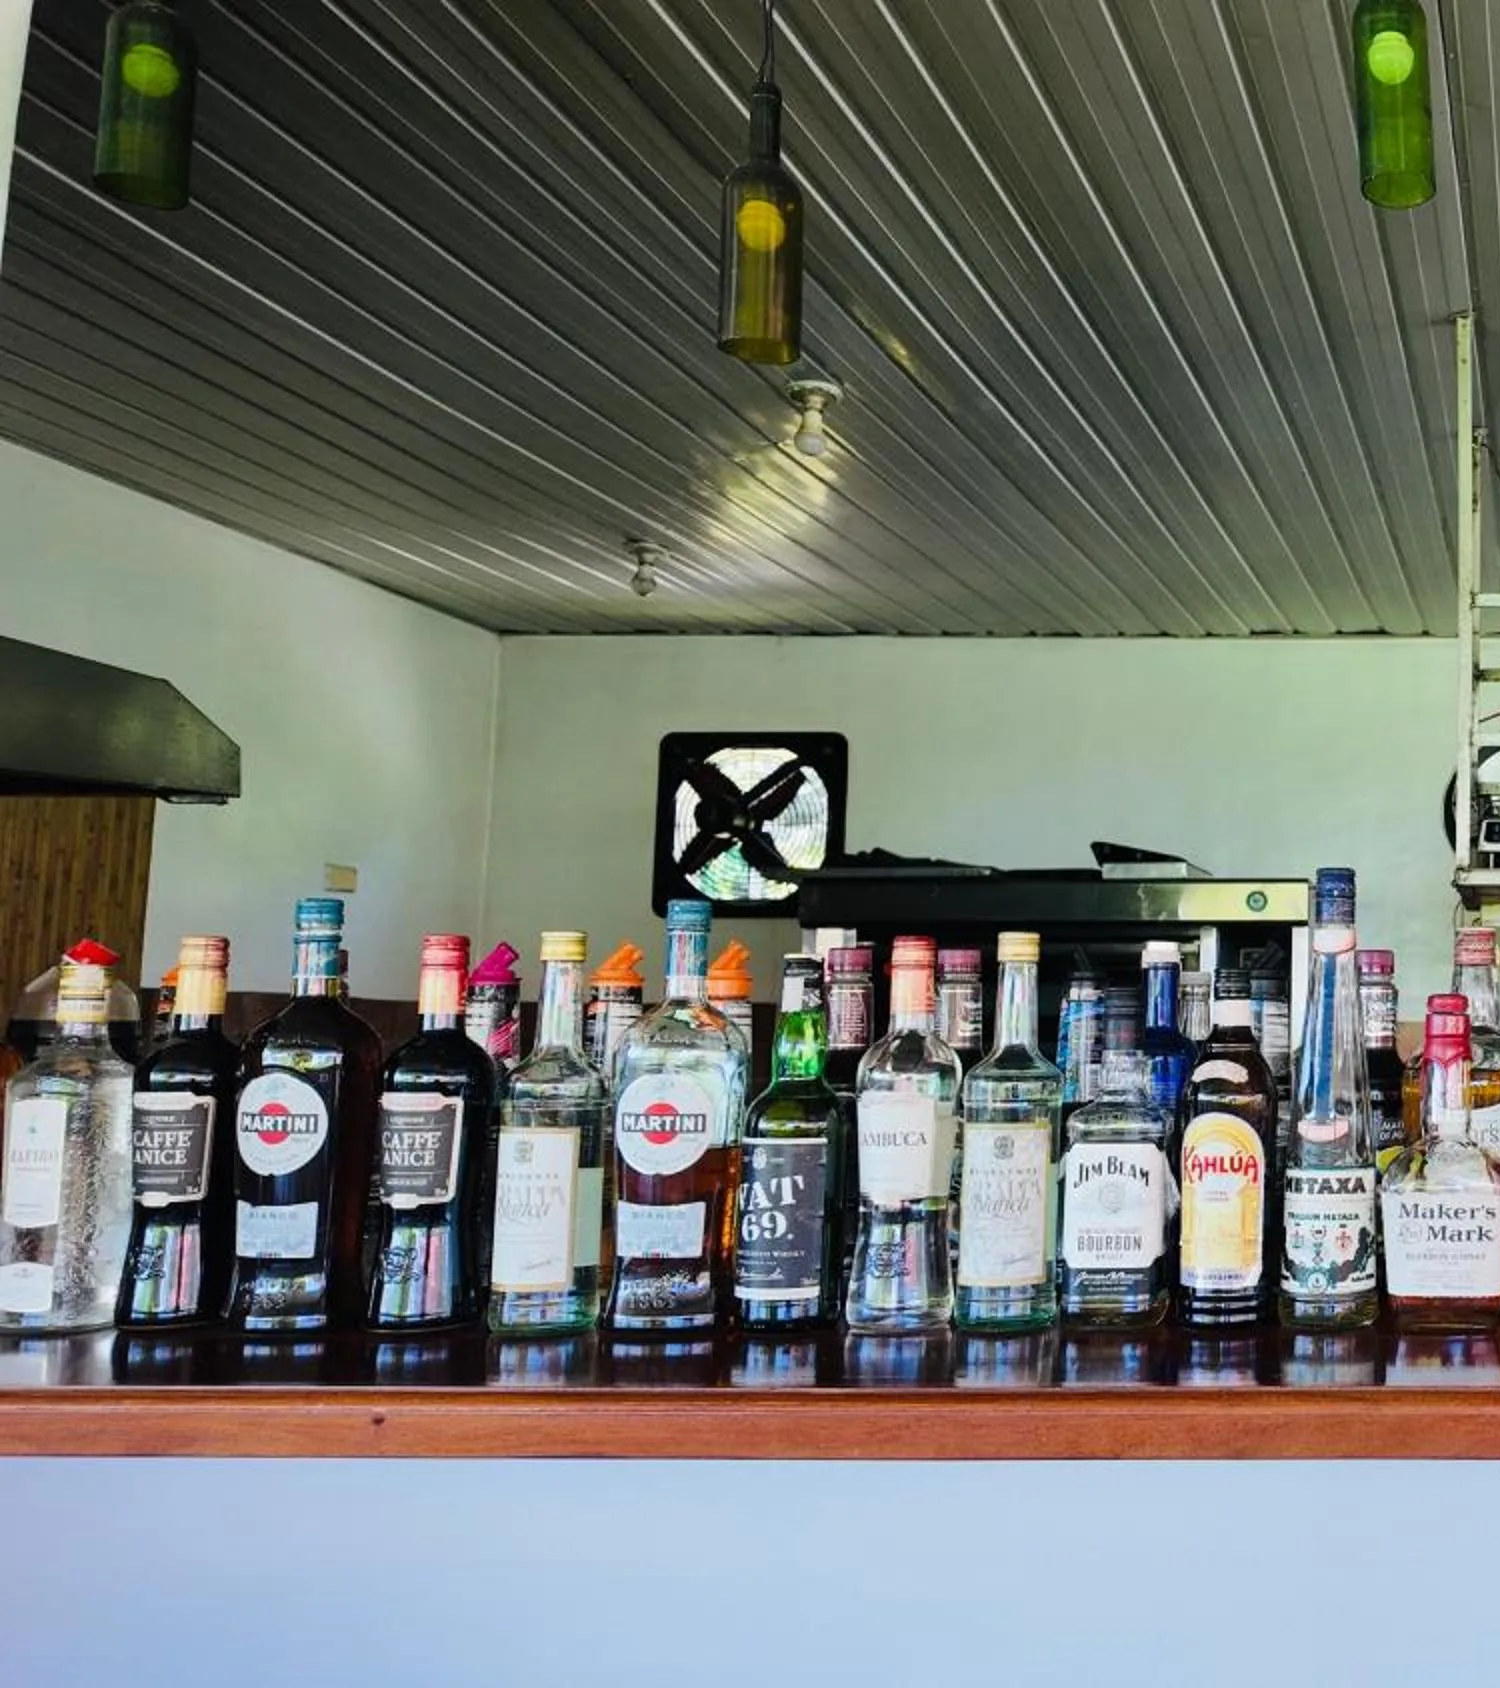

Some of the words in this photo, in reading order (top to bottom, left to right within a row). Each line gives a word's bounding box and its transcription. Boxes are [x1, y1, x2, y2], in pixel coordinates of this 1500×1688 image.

[241, 1114, 316, 1132] MARTINI
[623, 1115, 704, 1131] MARTINI
[862, 1133, 928, 1147] AMBUCA
[134, 1149, 188, 1165] ANICE
[383, 1151, 436, 1166] ANICE
[1183, 1144, 1260, 1184] KAHLÚA
[1073, 1162, 1103, 1189] JIM
[1107, 1155, 1150, 1188] BEAM
[738, 1175, 805, 1211] VAT
[1398, 1202, 1497, 1220] Maker's
[1427, 1224, 1494, 1241] Mark
[1077, 1235, 1143, 1251] BOURBON
